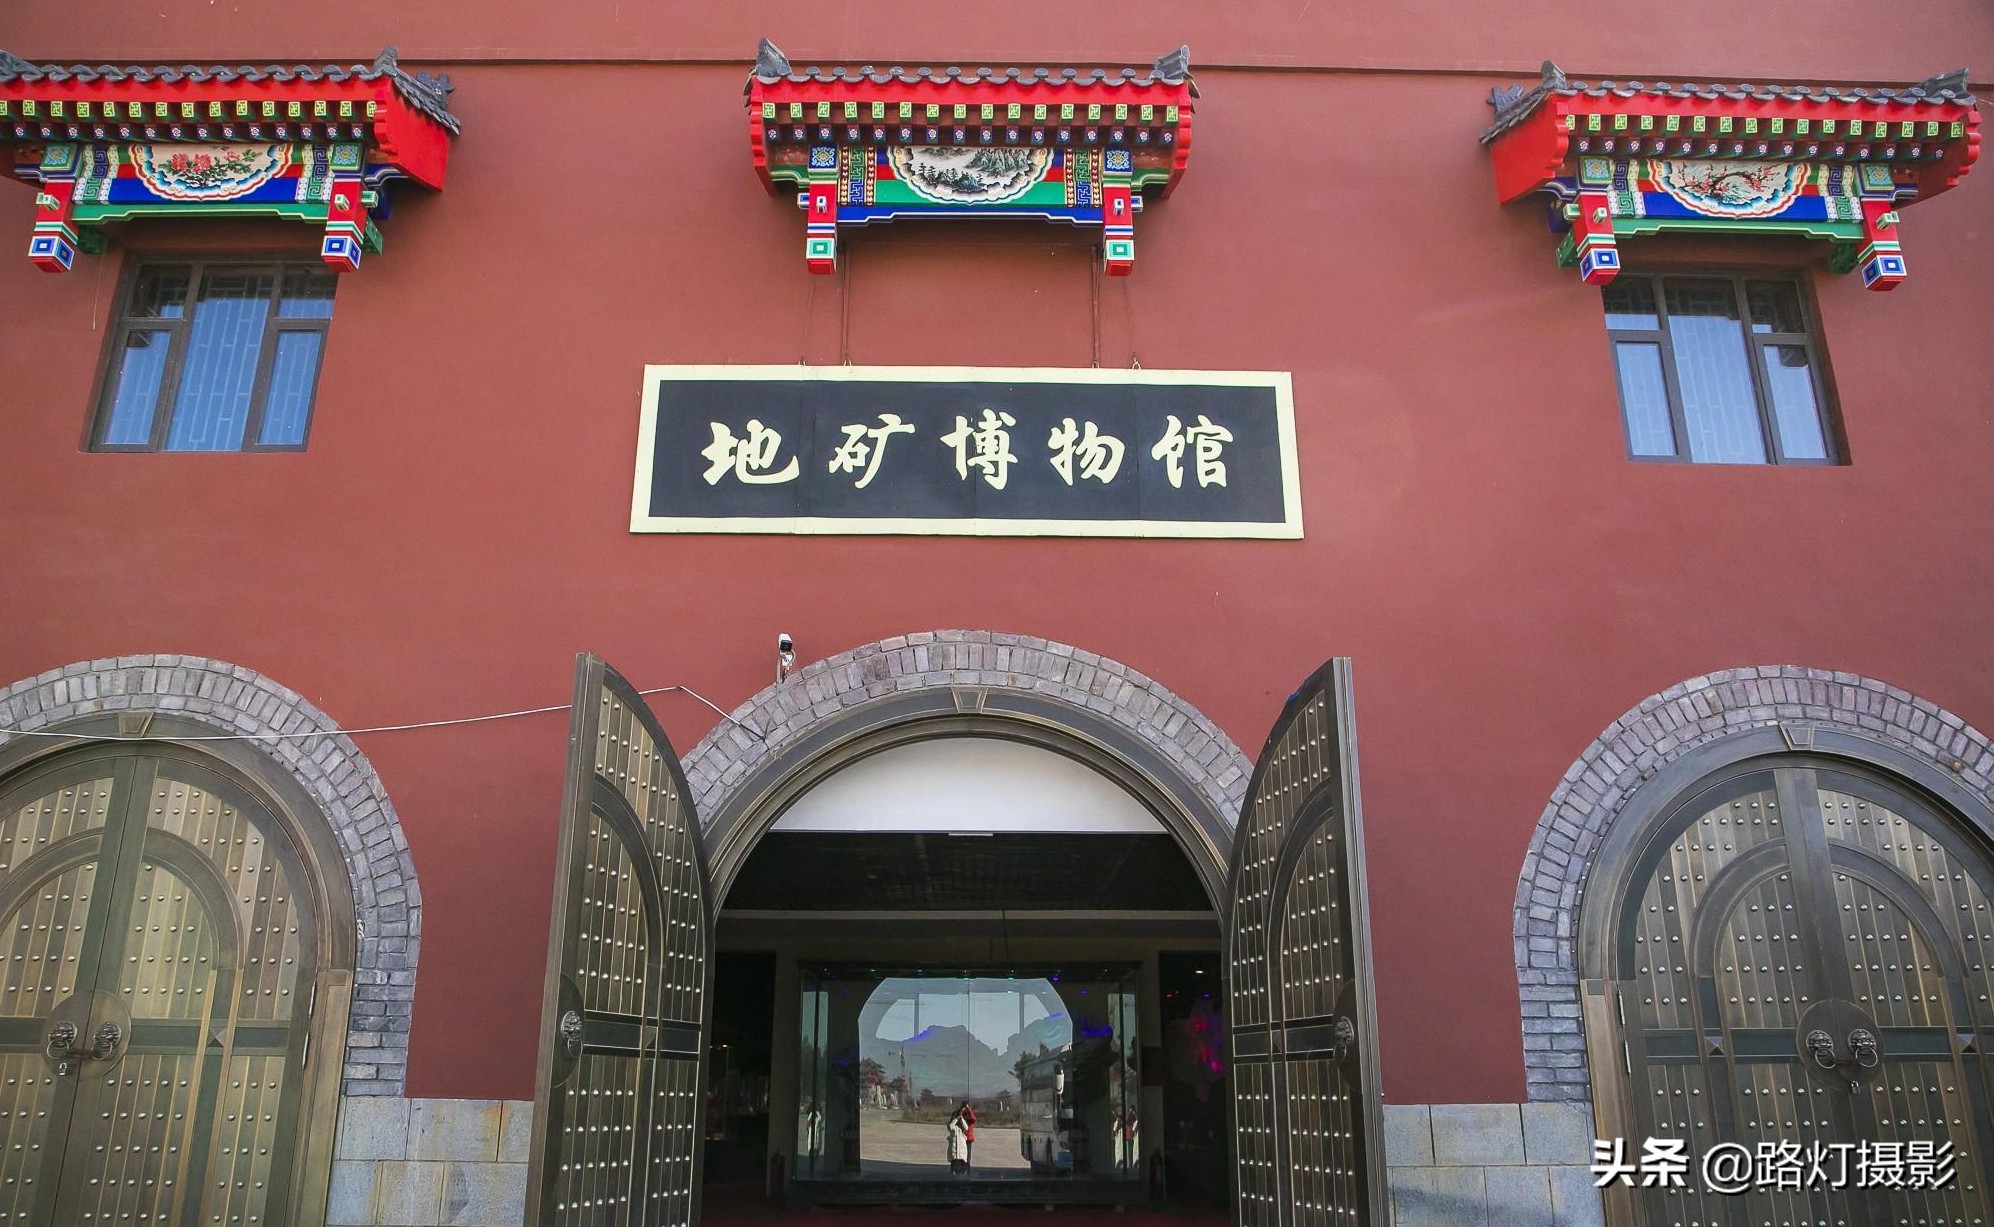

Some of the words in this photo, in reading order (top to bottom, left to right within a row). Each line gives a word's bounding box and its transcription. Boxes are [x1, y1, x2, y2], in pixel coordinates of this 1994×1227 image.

[701, 408, 1234, 490] 地矿博物馆
